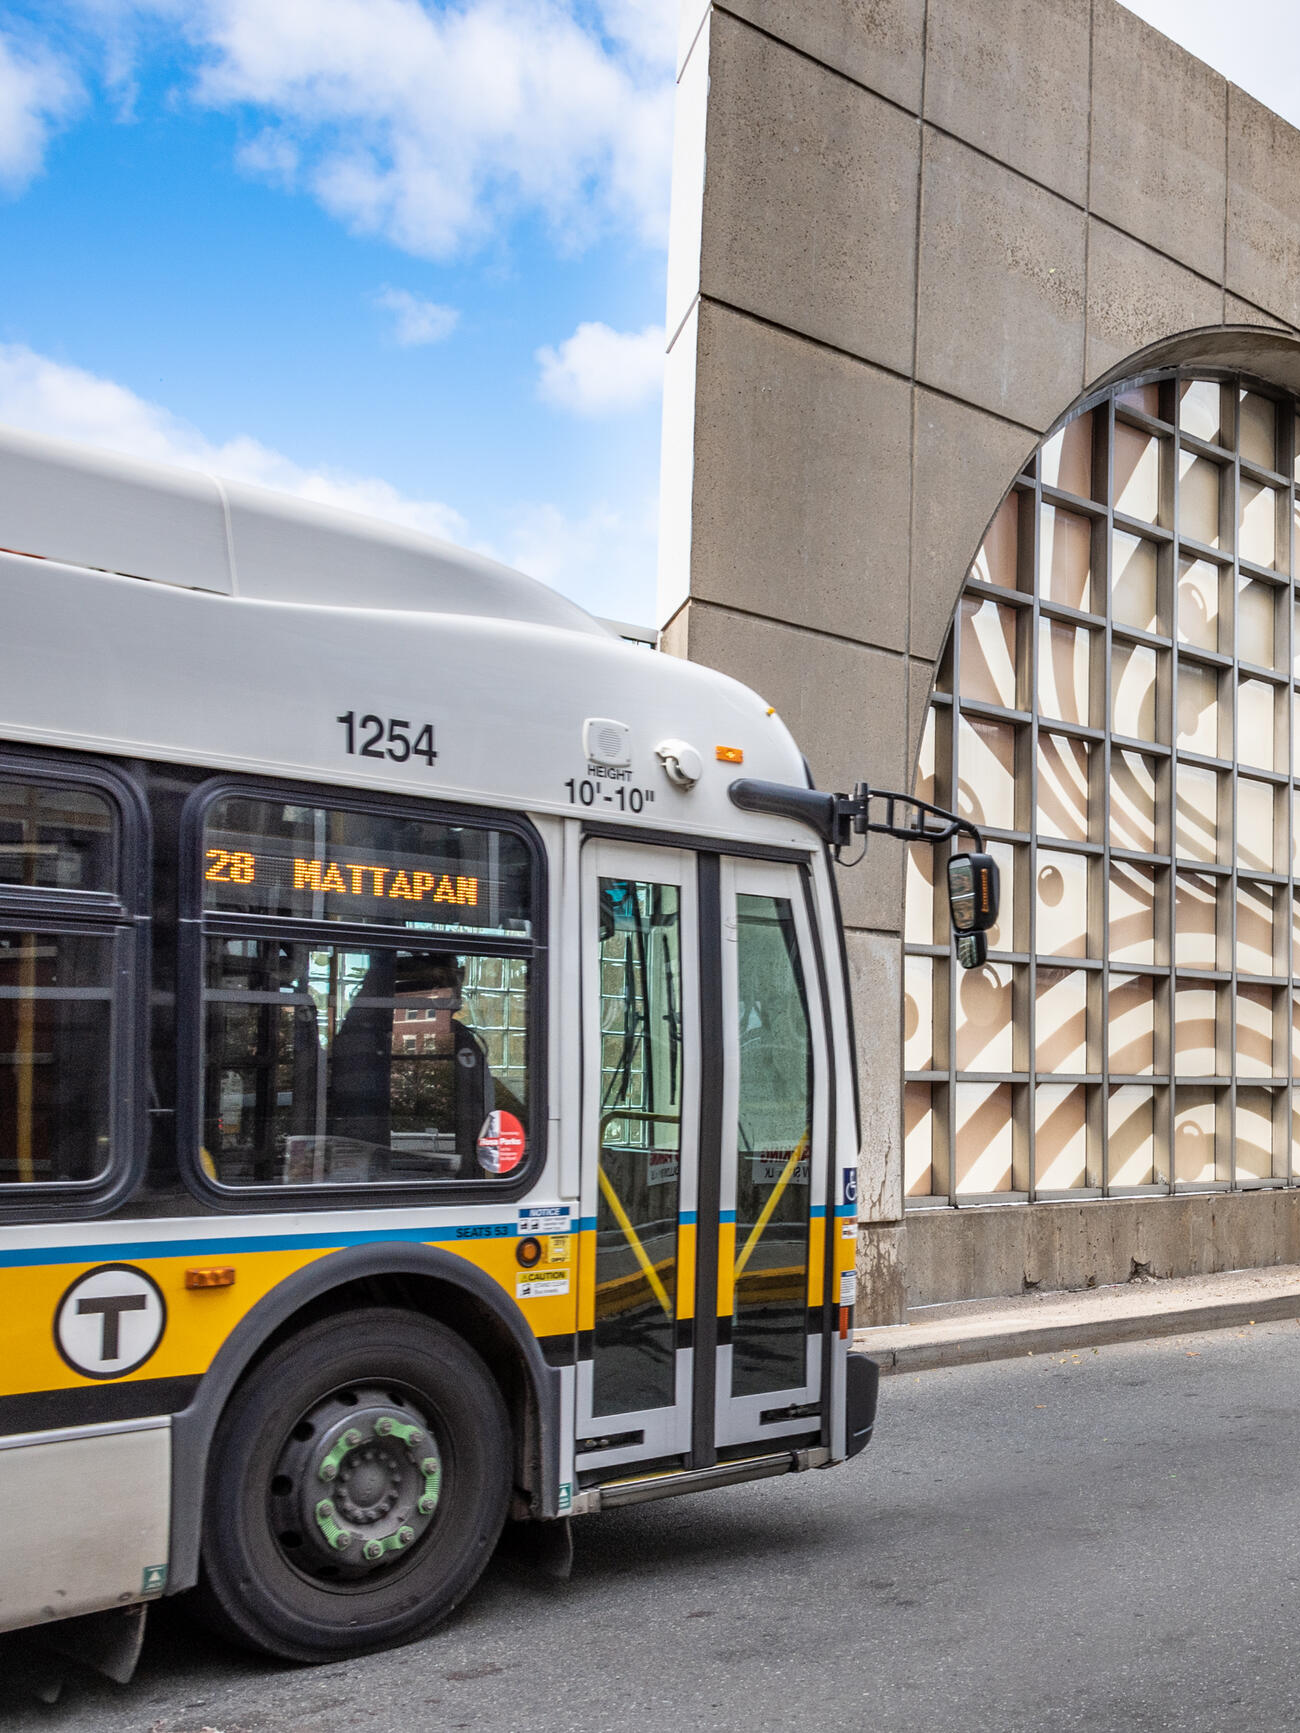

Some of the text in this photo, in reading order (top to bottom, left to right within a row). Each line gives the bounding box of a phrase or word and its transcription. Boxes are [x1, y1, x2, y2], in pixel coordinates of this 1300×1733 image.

[336, 710, 438, 766] 1254
[587, 764, 633, 782] HEIGHT
[564, 778, 655, 813] 10'-10"
[204, 849, 478, 906] 28 MATTAPAN
[529, 1207, 561, 1217] NOTICE
[456, 1226, 508, 1238] SEATS 53
[528, 1271, 566, 1281] CAUTION
[76, 1294, 146, 1360] T
